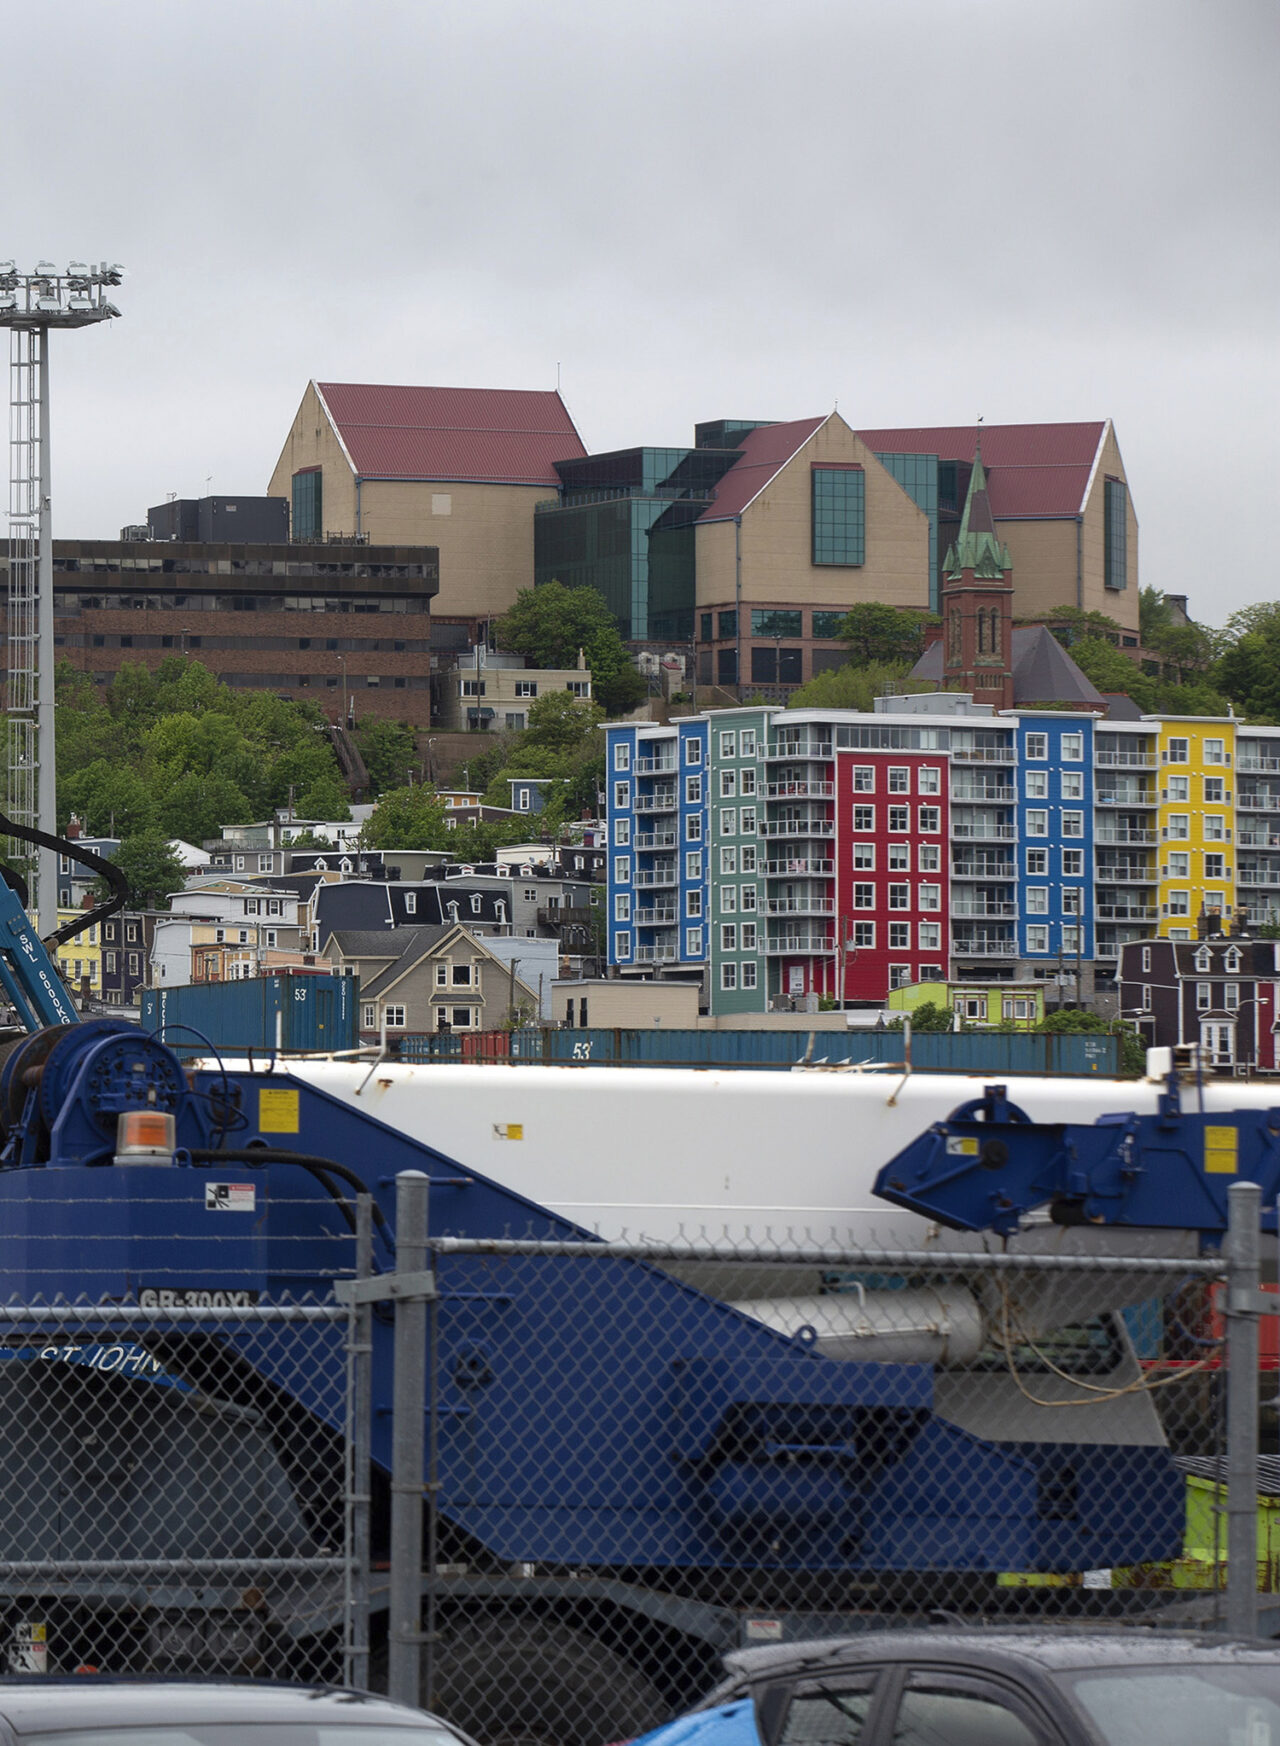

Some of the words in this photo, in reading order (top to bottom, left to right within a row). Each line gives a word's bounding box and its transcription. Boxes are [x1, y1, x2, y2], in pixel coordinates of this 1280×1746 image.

[19, 934, 38, 963] SWL
[38, 970, 70, 1025] 6000KG
[572, 1041, 594, 1060] 53'
